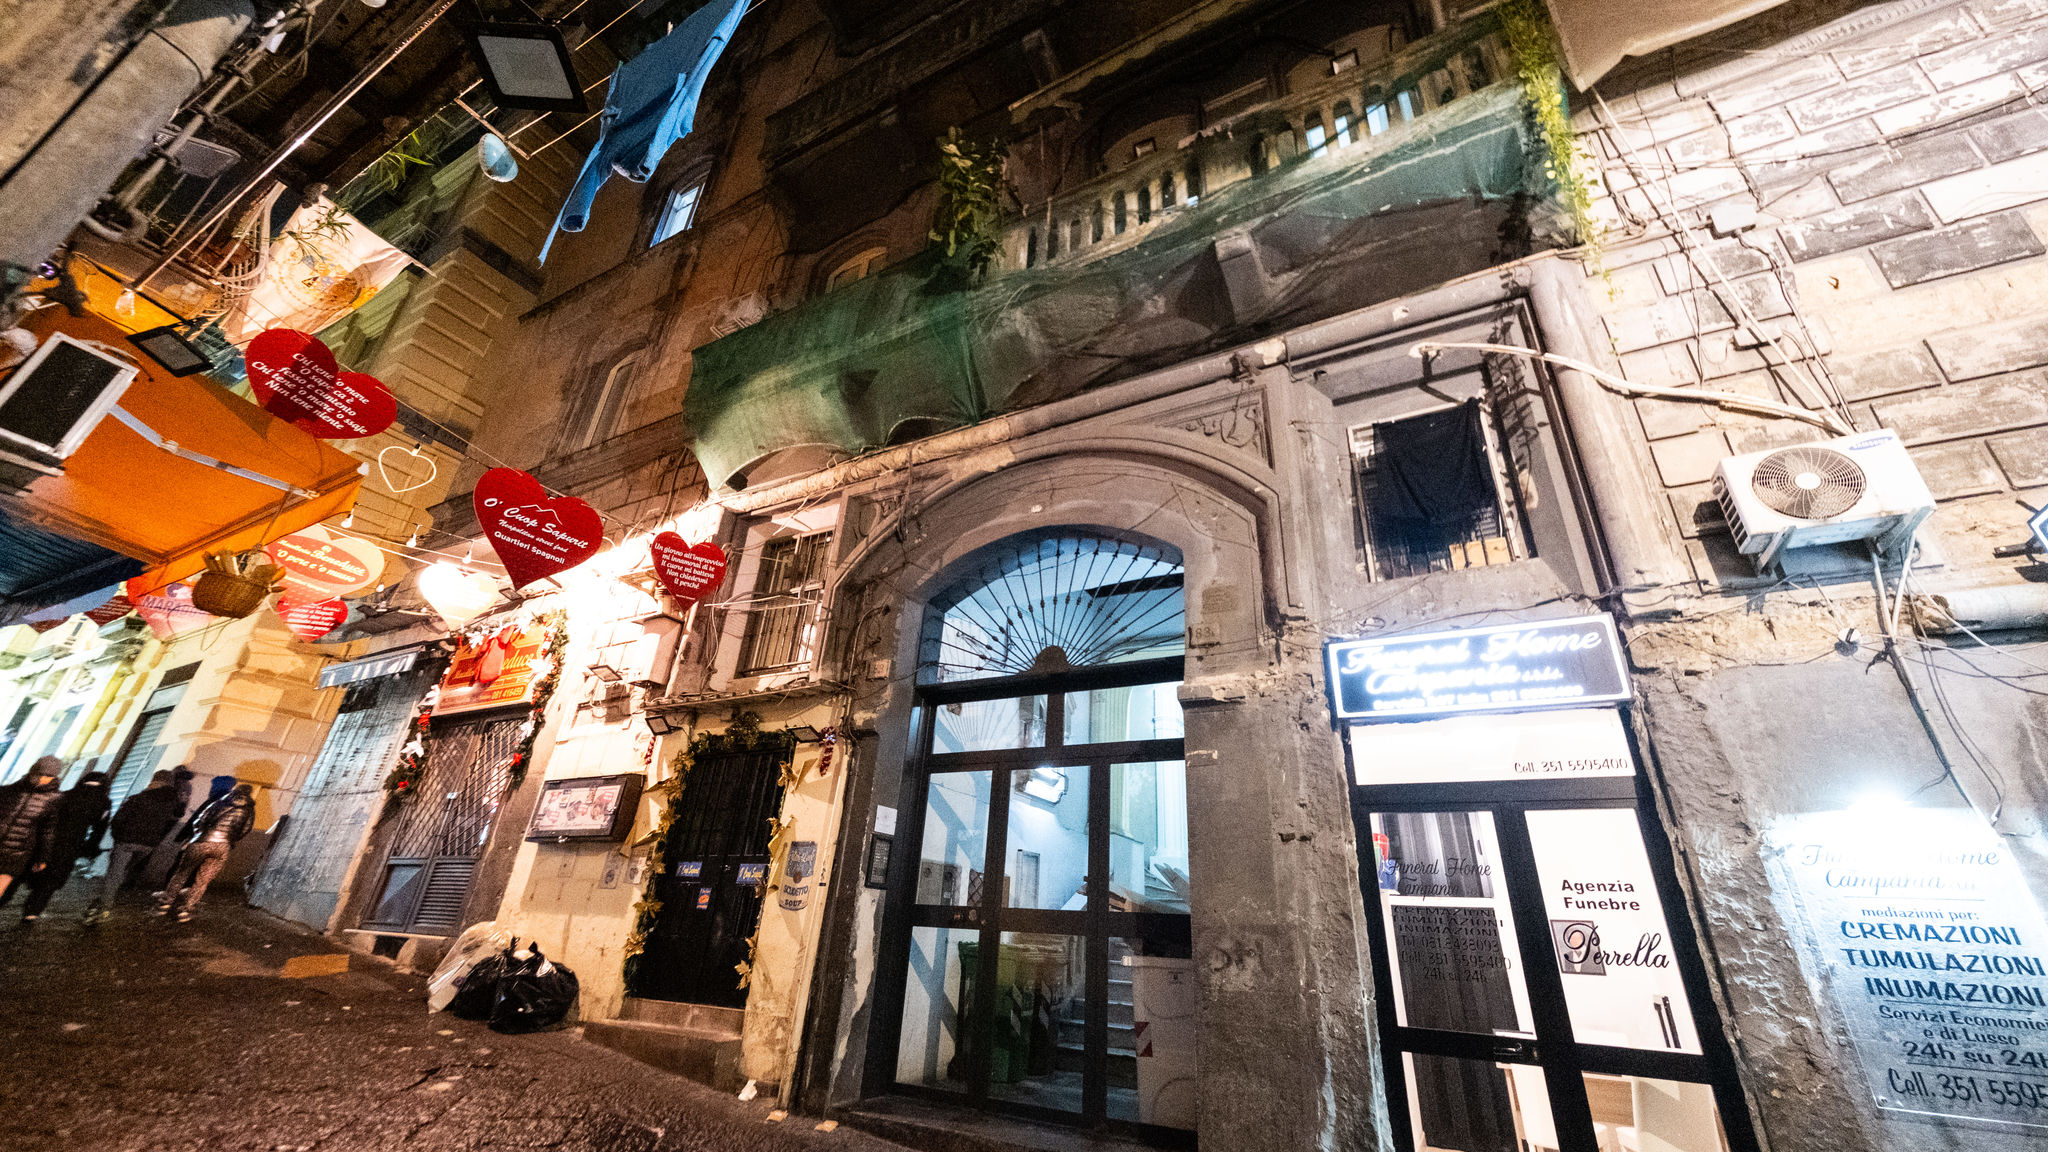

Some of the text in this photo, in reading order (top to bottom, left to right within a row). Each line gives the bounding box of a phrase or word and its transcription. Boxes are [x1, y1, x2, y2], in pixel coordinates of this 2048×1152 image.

[277, 366, 357, 416] fesso e cuntento
[293, 353, 313, 367] Chi
[311, 362, 335, 381] tene
[344, 384, 369, 405] mare
[309, 373, 334, 391] sape
[333, 387, 346, 399] ca
[251, 361, 274, 375] Chi
[271, 371, 296, 390] tene
[306, 394, 335, 413] mare
[343, 416, 368, 435] ssaje
[264, 379, 345, 430] Nun tene niente
[503, 507, 538, 527] Cuop
[494, 530, 565, 564] Quartieri Spagnoli
[498, 519, 569, 553] Neapolitan street food
[310, 549, 366, 575] Beneduce
[655, 543, 725, 568] Un giorno all'improvviso
[671, 556, 702, 569] innamorai
[666, 562, 683, 571] cuore
[693, 568, 715, 579] batteva
[666, 569, 709, 584] Non chiedermi
[1341, 630, 1602, 674] Funeral Home
[1365, 663, 1521, 698] Campania
[1541, 760, 1563, 772] 351
[1386, 857, 1492, 877] Funeral Home
[1398, 876, 1459, 901] Campania
[1562, 879, 1634, 894] Agenzia
[1825, 868, 1946, 895] Campania
[785, 899, 802, 907] SOUP
[1394, 906, 1495, 918] CREMAZIONI
[1563, 897, 1640, 910] Funebre
[1861, 906, 1980, 922] mediazioni per:
[1393, 916, 1503, 928] TUMULAZIONI
[1399, 925, 1497, 937] INUMAZIONI
[1840, 920, 2022, 946] CREMAZIONI
[1562, 922, 1669, 968] Perrella
[1840, 948, 2046, 976] TUMULAZIONI
[1864, 977, 2047, 1007] INUMAZIONI
[1878, 1004, 1946, 1023] Servizi
[1923, 1026, 2020, 1046] e di Lusso
[1903, 1041, 1956, 1061] 24h
[1963, 1051, 1995, 1065] su
[1888, 1067, 1936, 1098] Cell.
[1937, 1073, 1983, 1103] 351
